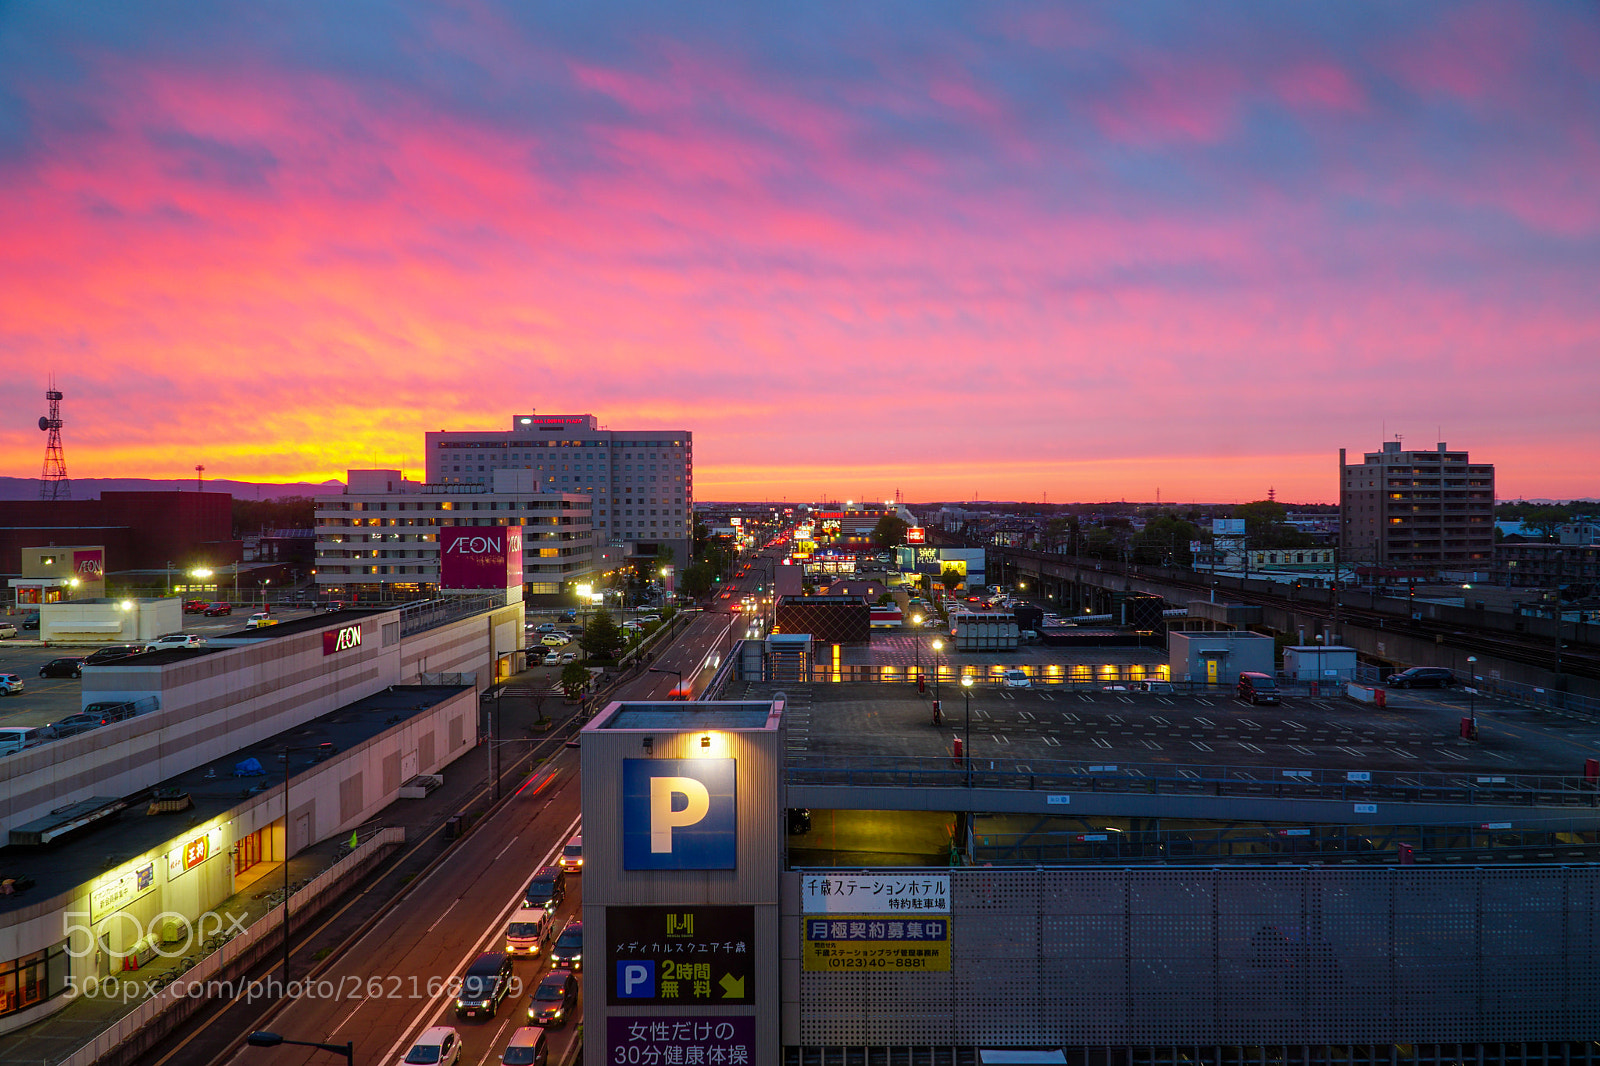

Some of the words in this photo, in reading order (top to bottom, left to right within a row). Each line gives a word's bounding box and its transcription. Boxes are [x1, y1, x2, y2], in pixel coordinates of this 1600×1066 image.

[650, 776, 710, 853] P
[188, 841, 204, 863] 王将
[807, 879, 946, 896] 千歳ステーションホテル
[888, 898, 946, 910] 特約駐車場
[811, 921, 943, 939] 月極契約募集中
[616, 941, 746, 954] メディカルスクエア千歳
[625, 965, 648, 995] P
[661, 959, 711, 980] 2時間
[628, 1021, 735, 1042] 女性だけの
[614, 1045, 749, 1066] 30分健康体操
